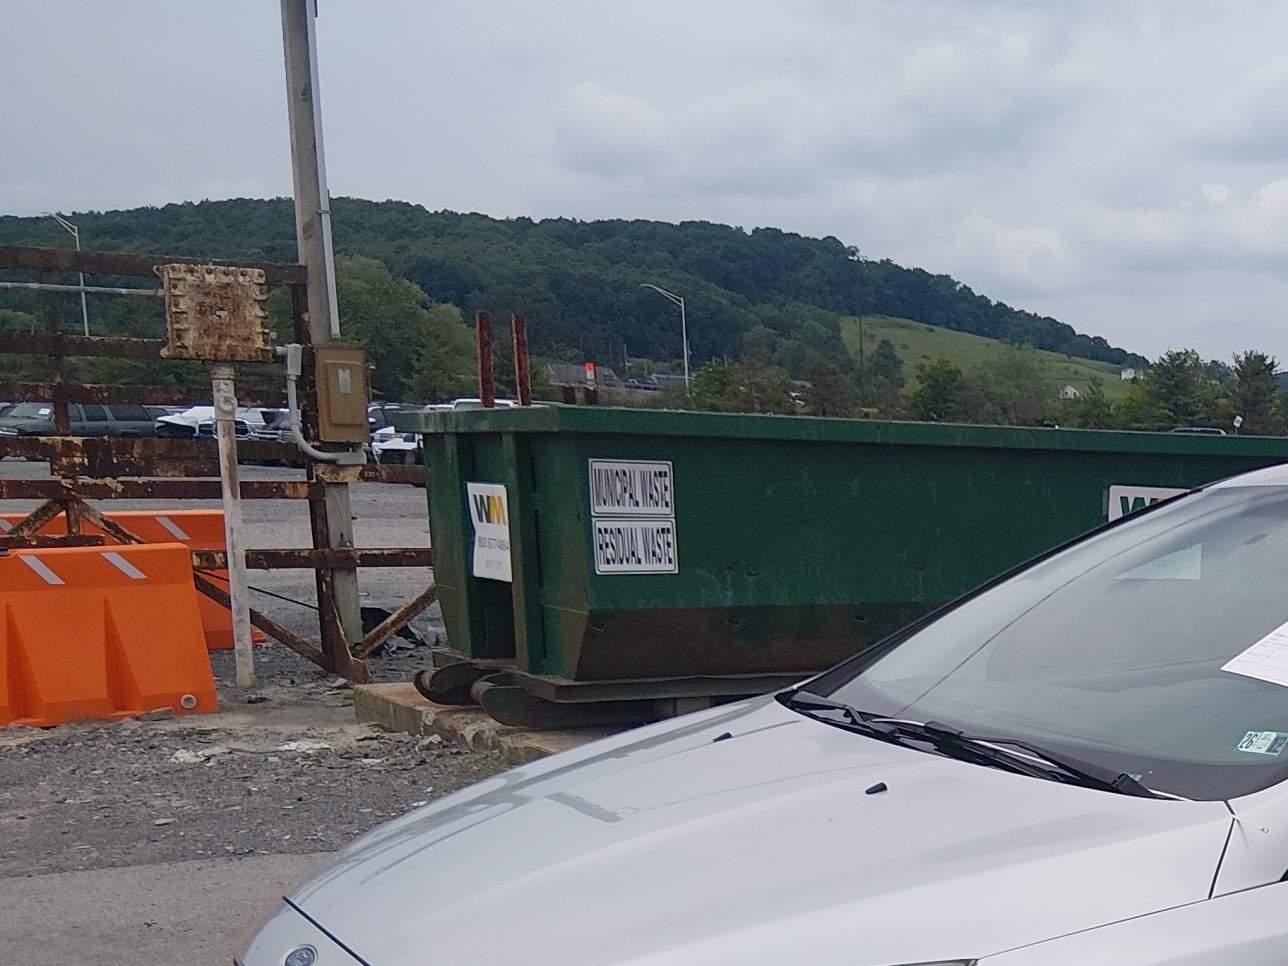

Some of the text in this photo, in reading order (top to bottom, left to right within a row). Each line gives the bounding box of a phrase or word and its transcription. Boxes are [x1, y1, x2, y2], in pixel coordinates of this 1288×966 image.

[594, 467, 670, 508] MUNICIPAL WASTE
[473, 493, 508, 526] WM
[598, 527, 673, 565] RESIDUAL WASTE
[1239, 732, 1259, 749] 26
